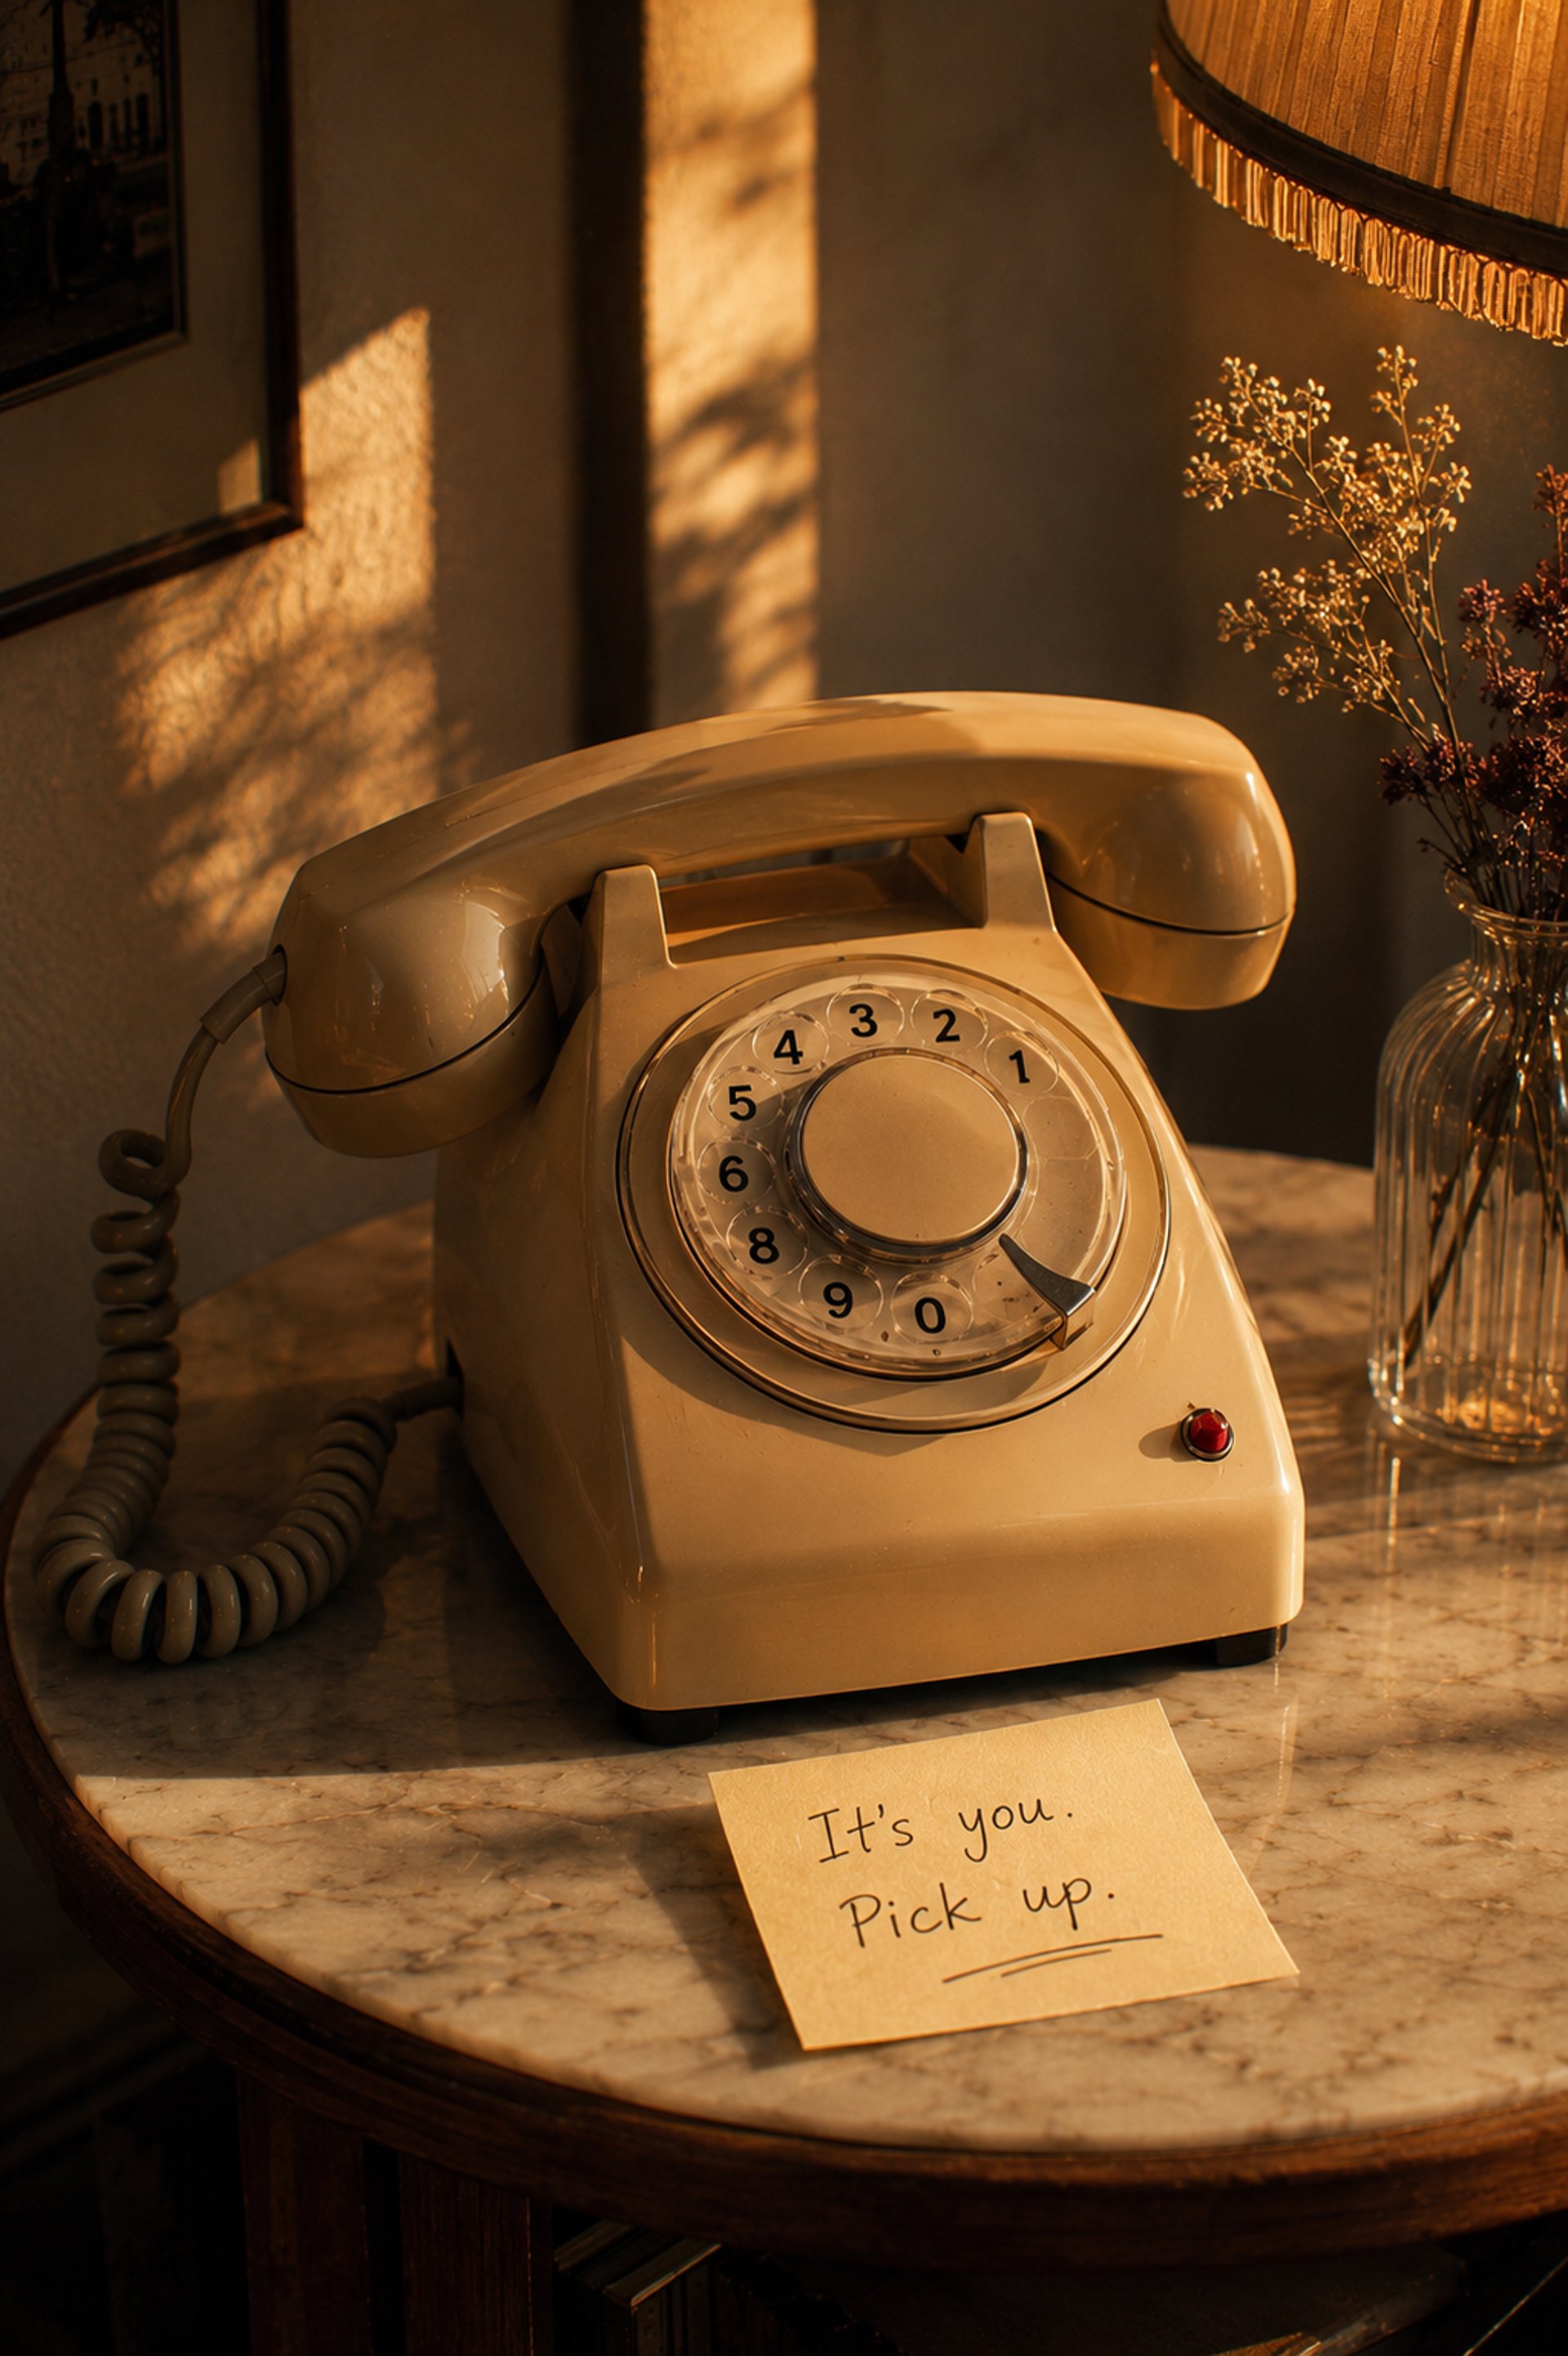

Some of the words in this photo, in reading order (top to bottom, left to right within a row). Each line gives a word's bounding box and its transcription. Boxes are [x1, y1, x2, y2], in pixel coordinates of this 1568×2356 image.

[849, 1003, 878, 1038] 3
[933, 1008, 960, 1043] 2
[773, 1029, 804, 1065] 4
[1009, 1049, 1031, 1084] 1
[728, 1084, 758, 1122] 5
[719, 1155, 750, 1193] 6
[748, 1227, 780, 1265] 8
[822, 1281, 853, 1319] 9
[914, 1296, 947, 1334] 0
[808, 1803, 914, 1863] It's
[957, 1798, 1073, 1863] you.
[840, 1881, 982, 1948] Pick
[1022, 1877, 1115, 1931] up.
